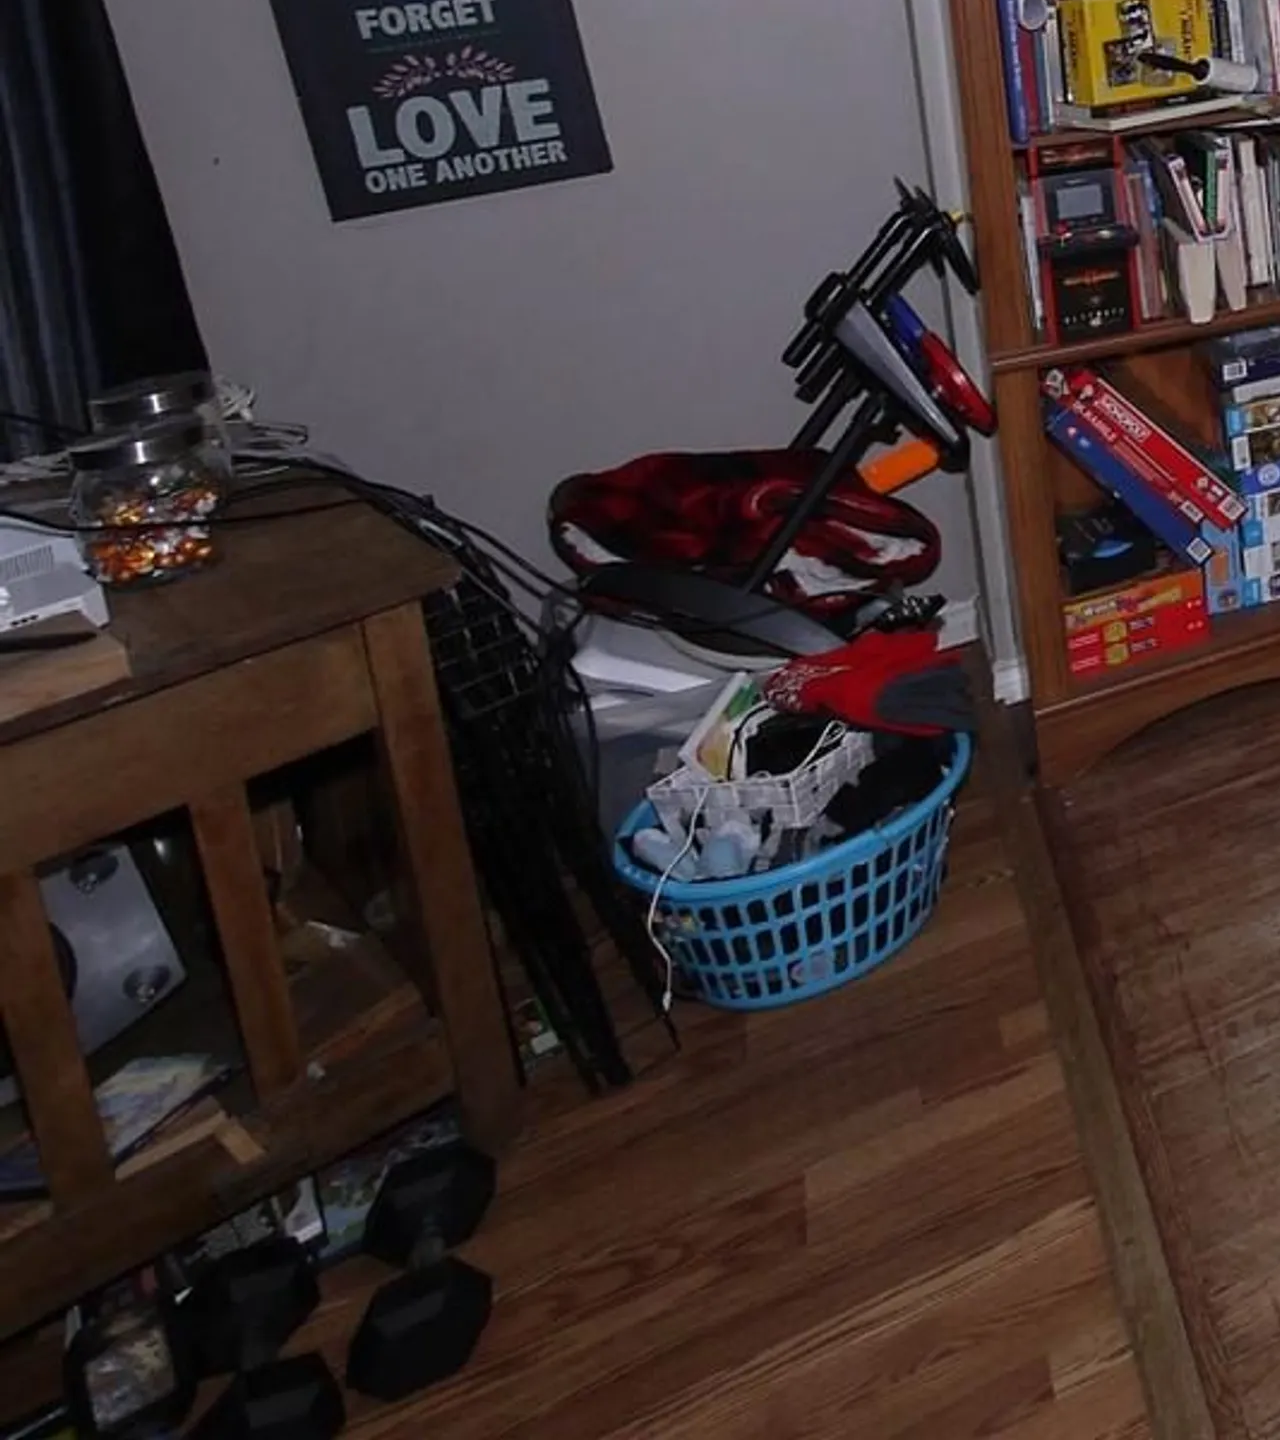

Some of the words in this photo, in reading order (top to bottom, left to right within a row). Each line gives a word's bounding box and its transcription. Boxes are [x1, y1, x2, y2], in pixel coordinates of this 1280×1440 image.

[345, 77, 561, 170] LOVE
[365, 163, 428, 195] ONE
[435, 139, 568, 186] ANOTHER
